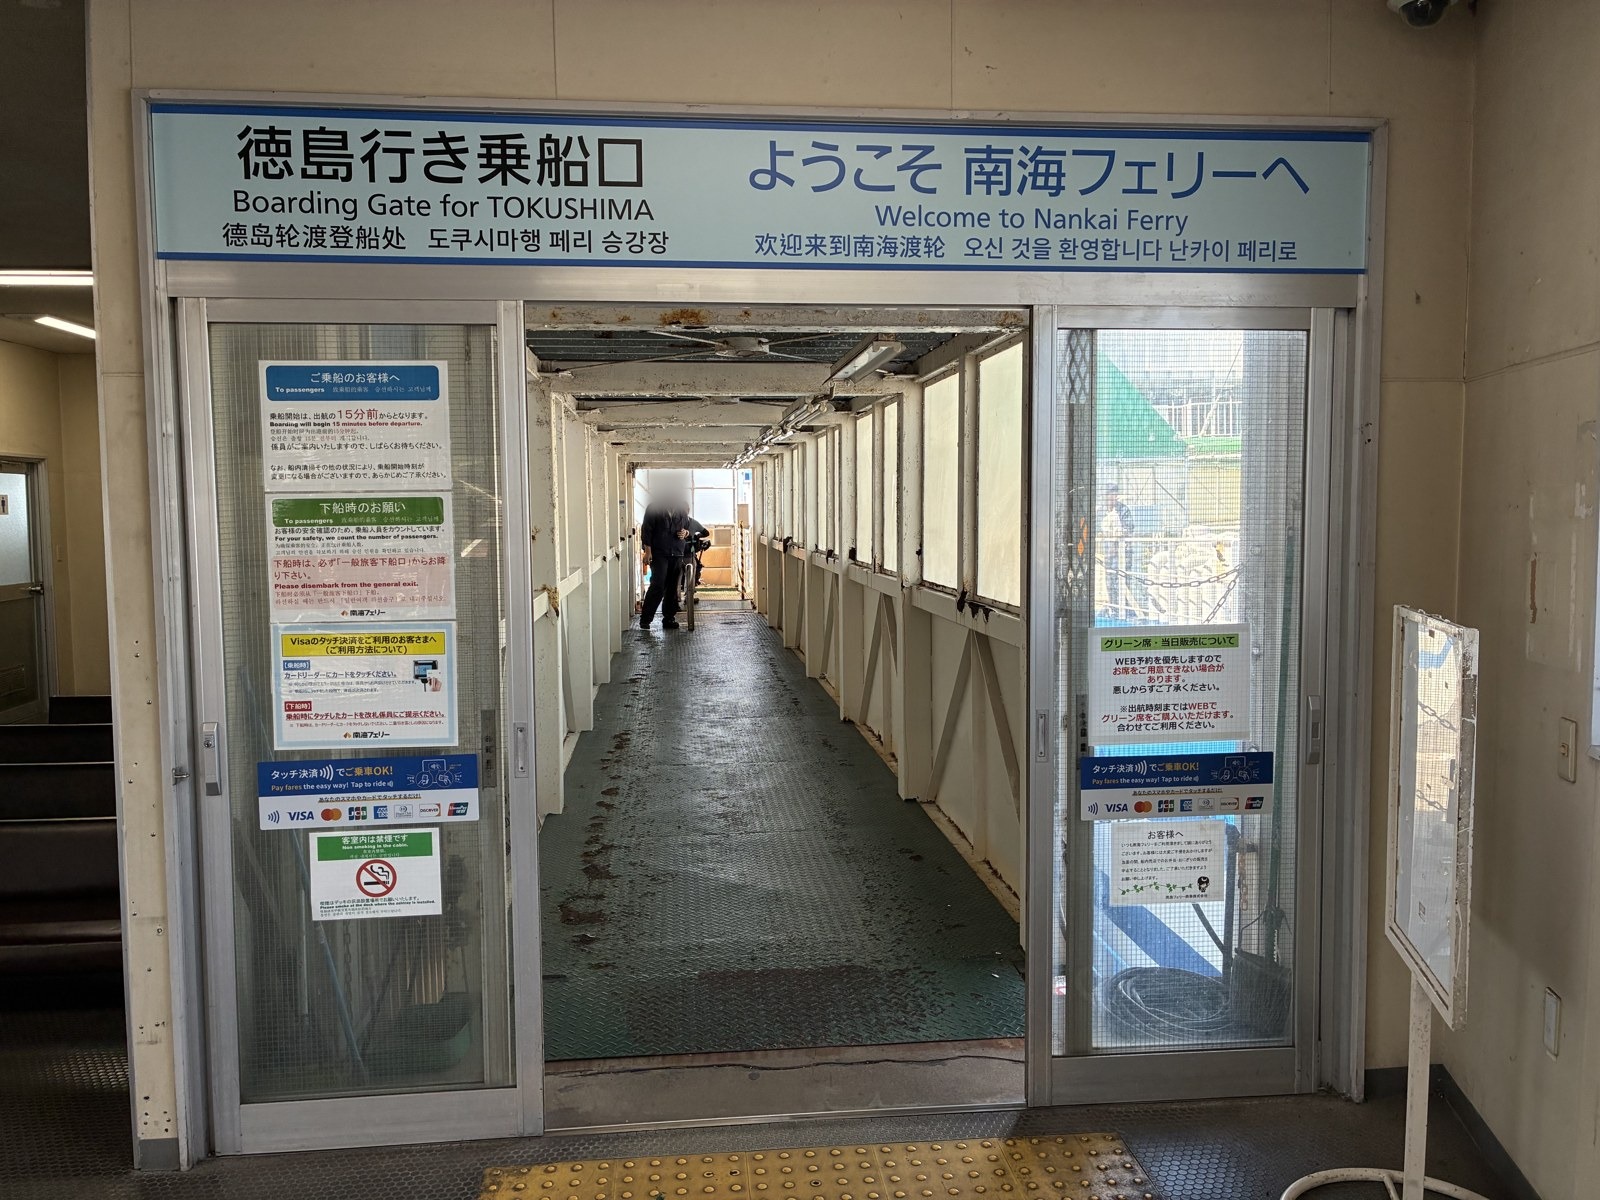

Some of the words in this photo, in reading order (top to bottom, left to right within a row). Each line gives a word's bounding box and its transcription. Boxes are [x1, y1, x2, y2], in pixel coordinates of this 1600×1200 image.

[237, 125, 643, 188] 徳島行き乗船口
[748, 140, 942, 195] ようこそ
[963, 143, 1310, 199] 南海フェリーへ
[233, 189, 358, 221] Boarding
[368, 193, 431, 218] Gate
[439, 194, 479, 219] for
[487, 196, 653, 221] TOKUSHIMA
[875, 205, 991, 231] Welcome
[999, 210, 1024, 230] to
[1033, 207, 1119, 231] Nankai
[1127, 209, 1189, 237] Ferry
[221, 222, 406, 251] 德岛轮渡登船处
[428, 227, 542, 253] 도쿠시마행
[548, 228, 593, 254] 페리
[601, 228, 669, 256] 승강장
[754, 233, 946, 260] 欢迎来到南海渡轮
[963, 237, 1002, 261] 오신
[1010, 237, 1052, 261] 것을
[1058, 238, 1162, 262] 환영합니다
[1169, 238, 1230, 263] 난카이
[1237, 239, 1298, 263] 페리로
[311, 372, 400, 383] ご乗船のお客様へ
[319, 502, 406, 514] 下船時のお願い
[274, 571, 312, 580] り下さい。
[350, 609, 386, 617] 南海フェリー
[291, 635, 437, 646] Visaのタッチ決済をご利用のお客さまへ
[1104, 636, 1235, 648] グリーン席・当日販売について
[1115, 655, 1222, 665] WEB予約を優先しますので
[1113, 664, 1224, 675] お席をご用意できない場合が
[1147, 675, 1186, 683] あります。
[1113, 683, 1220, 694] 悪しからずご了承ください。
[1120, 702, 1217, 712] ※出航時刻まではWEBで
[1102, 711, 1234, 723] グリーン席をご購入いただけます。
[1117, 722, 1216, 732] 合わせてご利用ください。
[353, 731, 390, 739] 南海フェリー
[271, 767, 318, 780] タッチ決済
[336, 766, 393, 777] でご乗車OK!
[1093, 764, 1134, 774] タッチ決済
[271, 784, 282, 792] Pay
[284, 783, 302, 791] fares
[316, 783, 331, 791] easy
[333, 782, 349, 790] way!
[349, 808, 367, 818] JCB
[1104, 803, 1128, 812] VISA
[287, 811, 314, 821] VISA
[342, 834, 408, 844] 客室内は禁煙です
[1148, 830, 1183, 840] お客様へ
